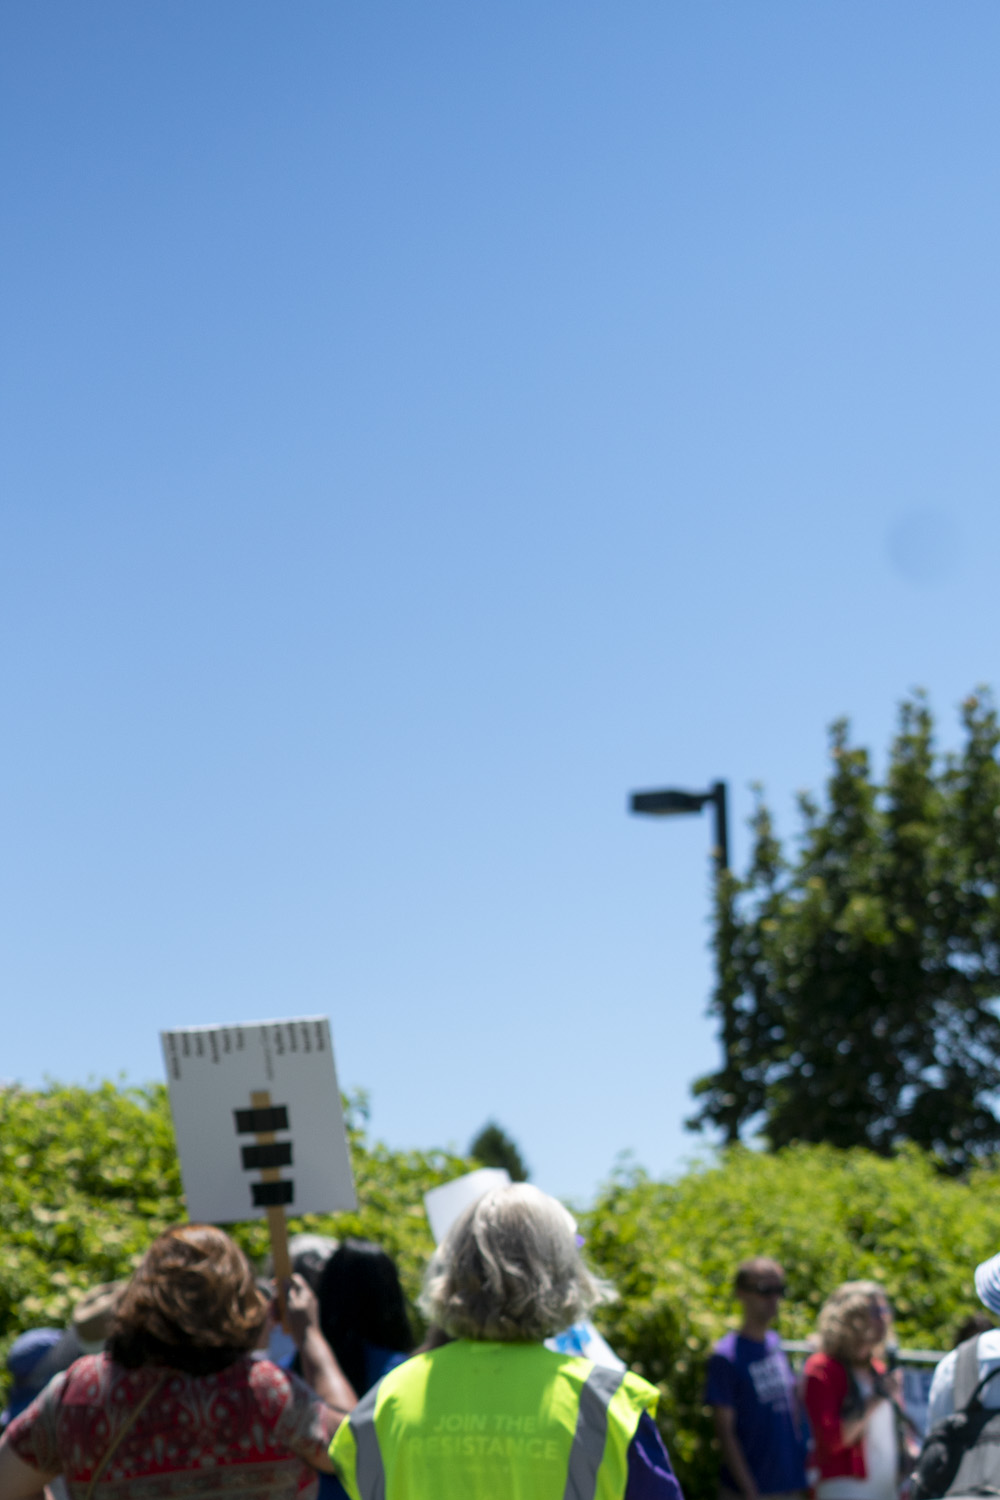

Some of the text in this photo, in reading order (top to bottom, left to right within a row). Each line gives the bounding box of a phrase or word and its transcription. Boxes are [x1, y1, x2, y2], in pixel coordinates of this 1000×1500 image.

[433, 1413, 537, 1434] JOIN THE
[408, 1435, 559, 1460] RESISTANCE
